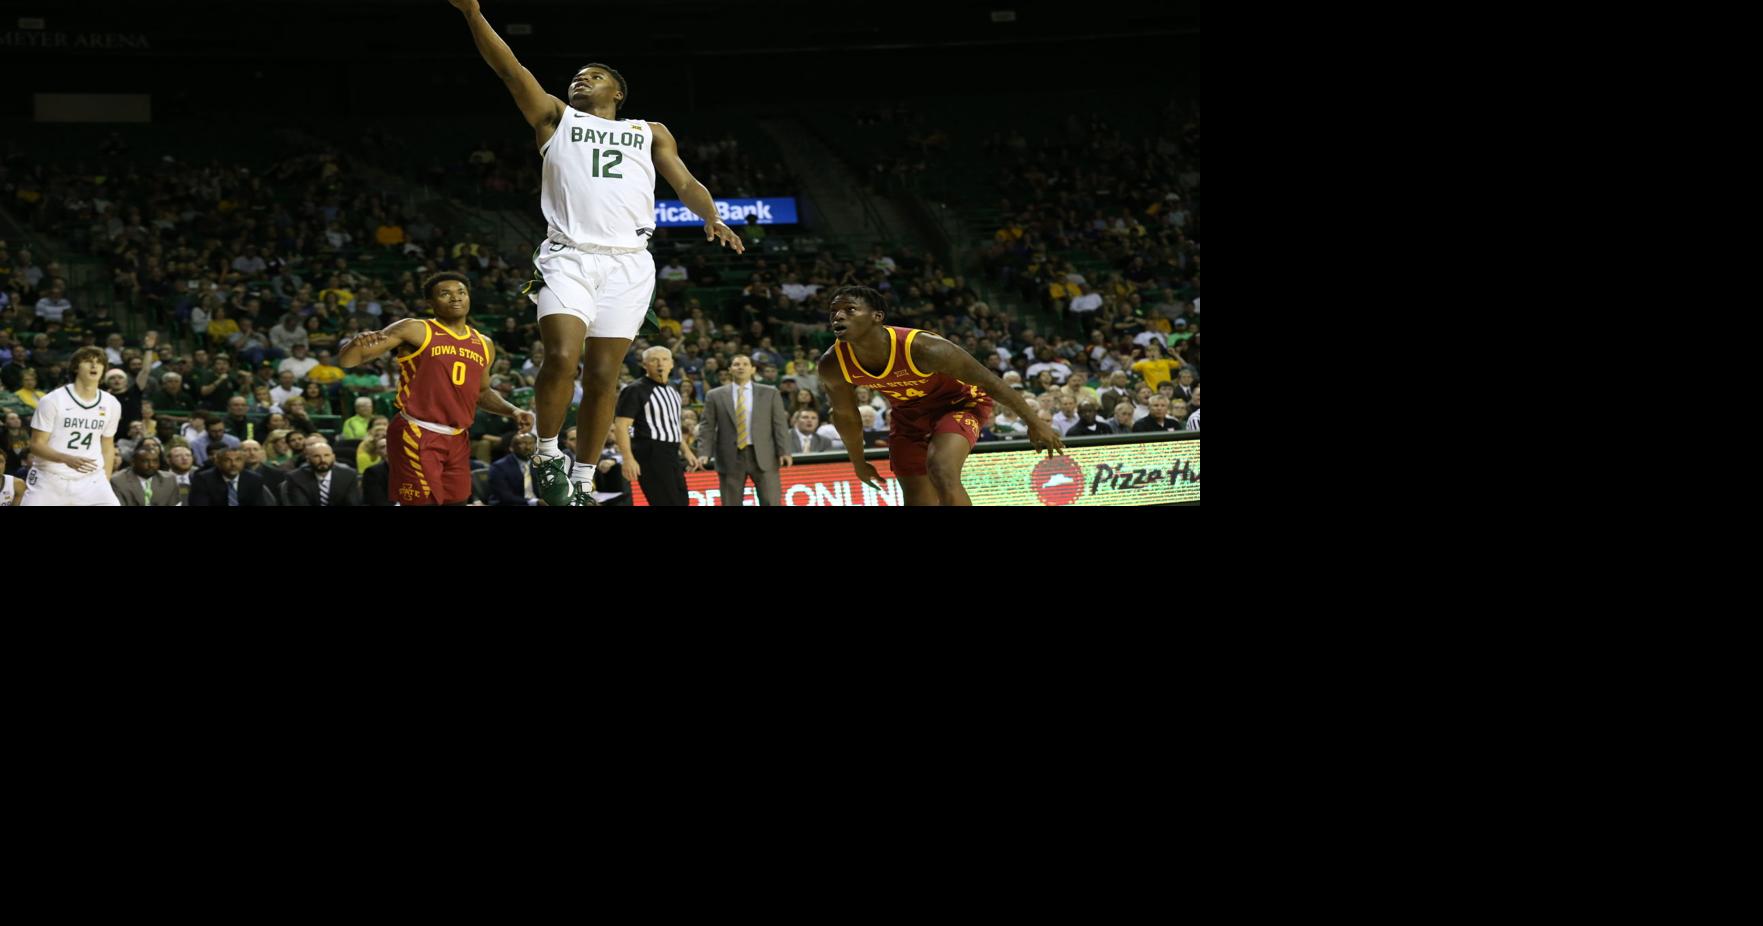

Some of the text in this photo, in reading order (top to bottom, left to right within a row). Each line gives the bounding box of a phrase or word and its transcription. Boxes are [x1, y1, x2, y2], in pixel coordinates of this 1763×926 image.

[73, 32, 149, 48] ARENA
[571, 127, 645, 150] BAYLOR
[592, 148, 623, 179] 12
[431, 346, 485, 367] IOWA STATE
[452, 361, 467, 386] 0
[63, 417, 105, 430] BAYLOR
[67, 431, 93, 450] 24
[1091, 462, 1163, 495] Pizza
